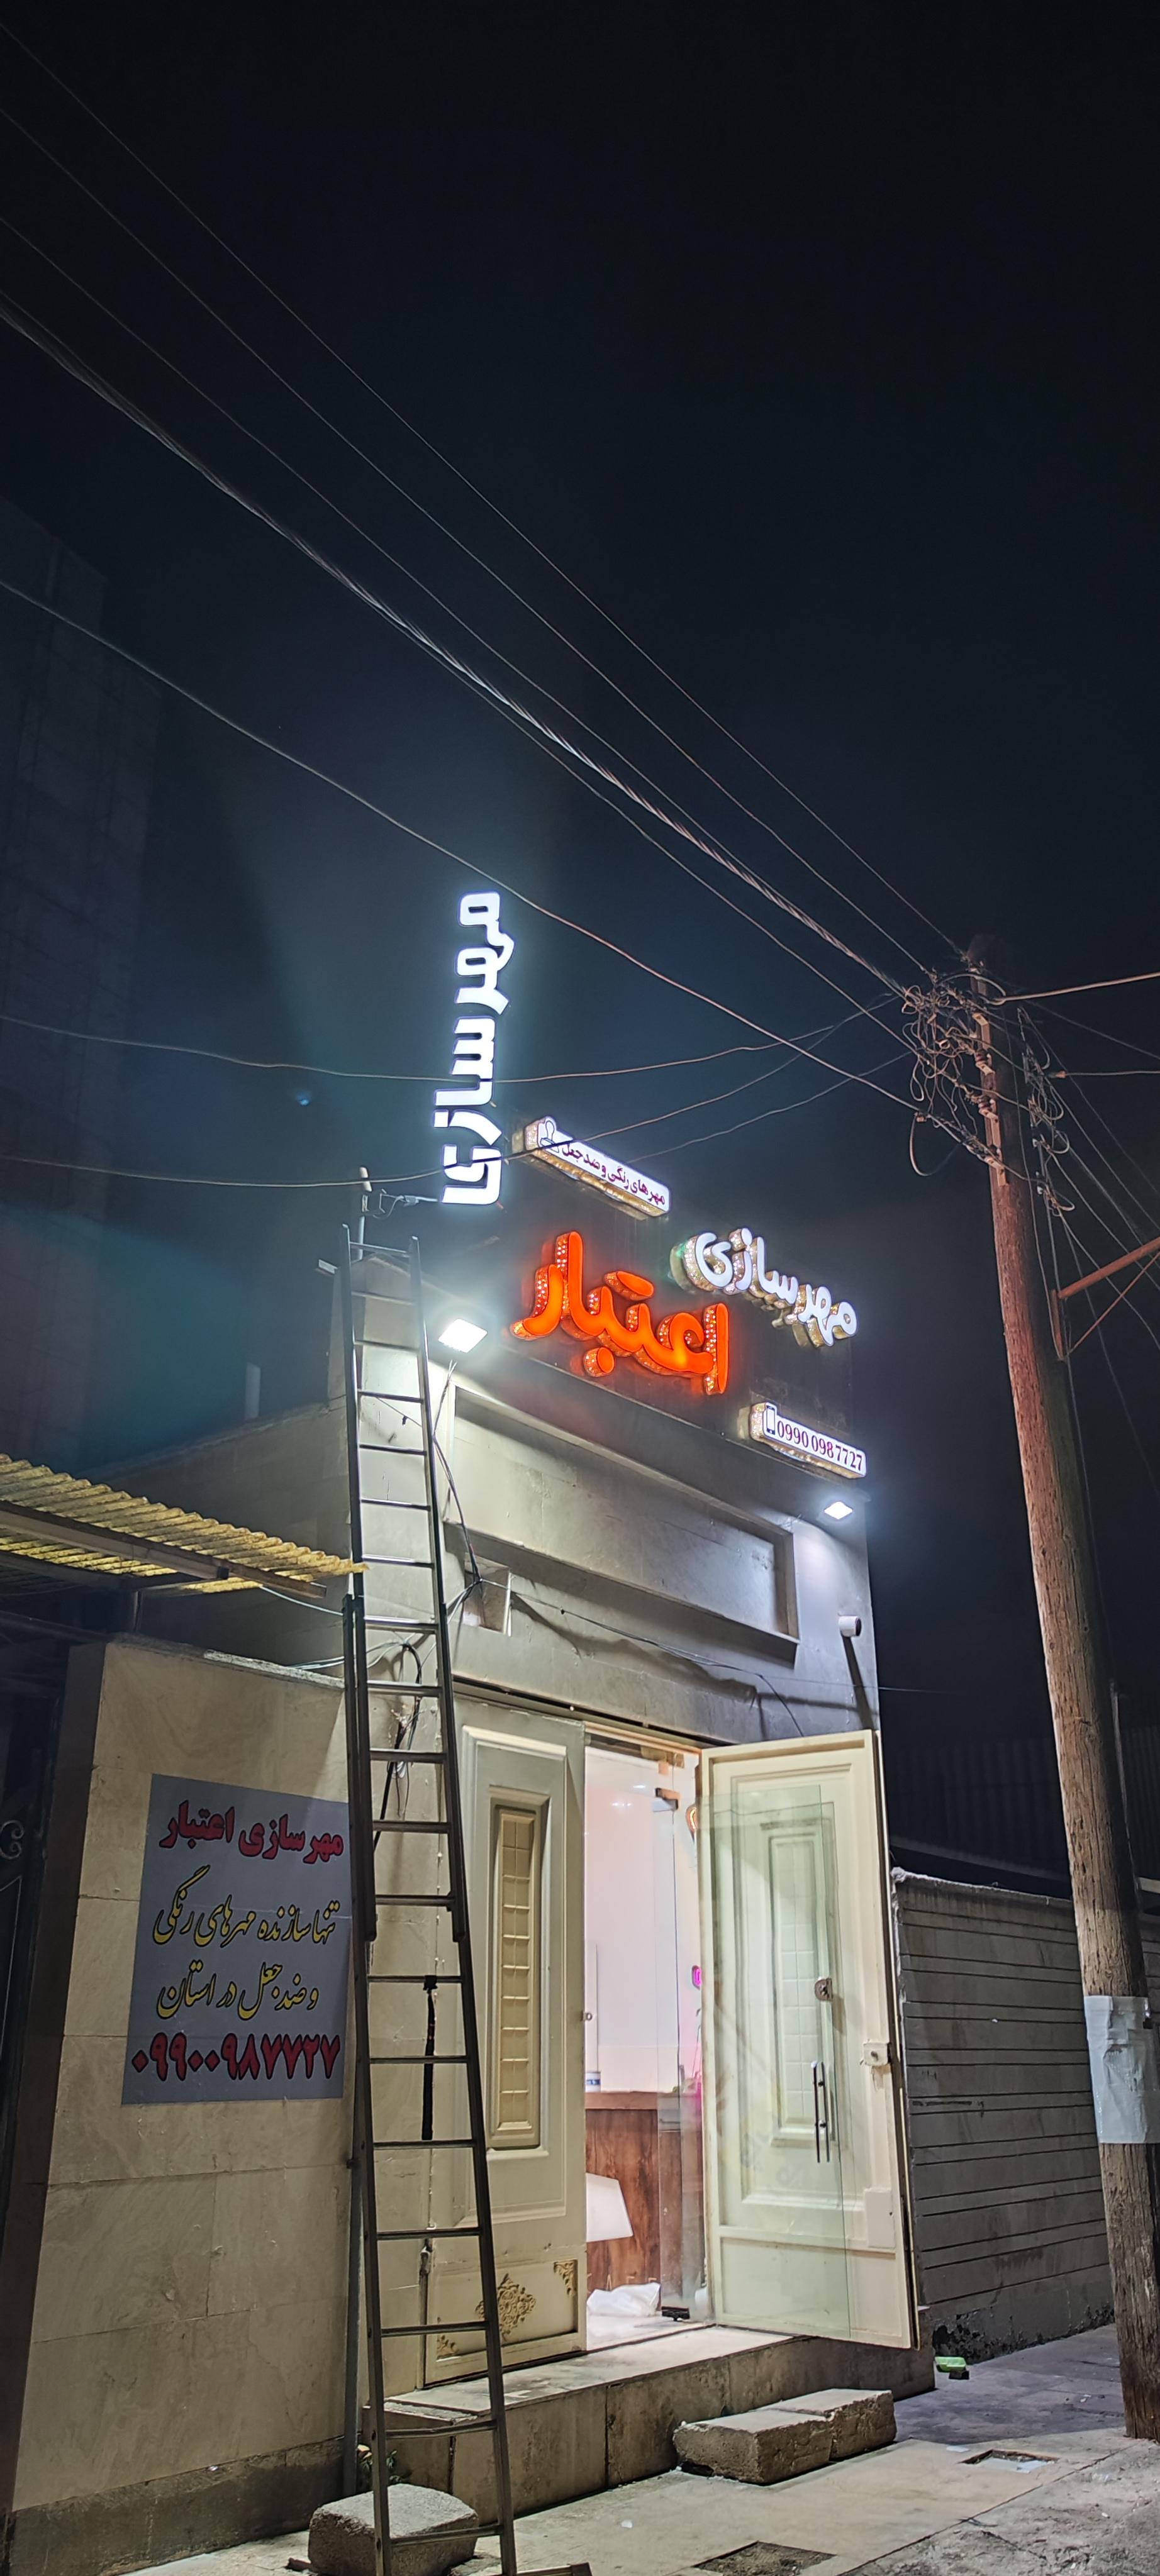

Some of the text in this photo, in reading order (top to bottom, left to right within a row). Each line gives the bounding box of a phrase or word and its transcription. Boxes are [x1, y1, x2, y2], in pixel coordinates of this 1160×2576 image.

[601, 1165, 606, 1178] و
[608, 1167, 629, 1190] رنگی
[518, 1231, 728, 1394] اعتبار
[159, 1799, 235, 1849] اعتبار
[153, 1865, 211, 1945] رنگی
[257, 1904, 311, 1942] سازنده
[312, 1901, 340, 1945] تنها
[157, 1959, 320, 2021] و ضد جعل در استان
